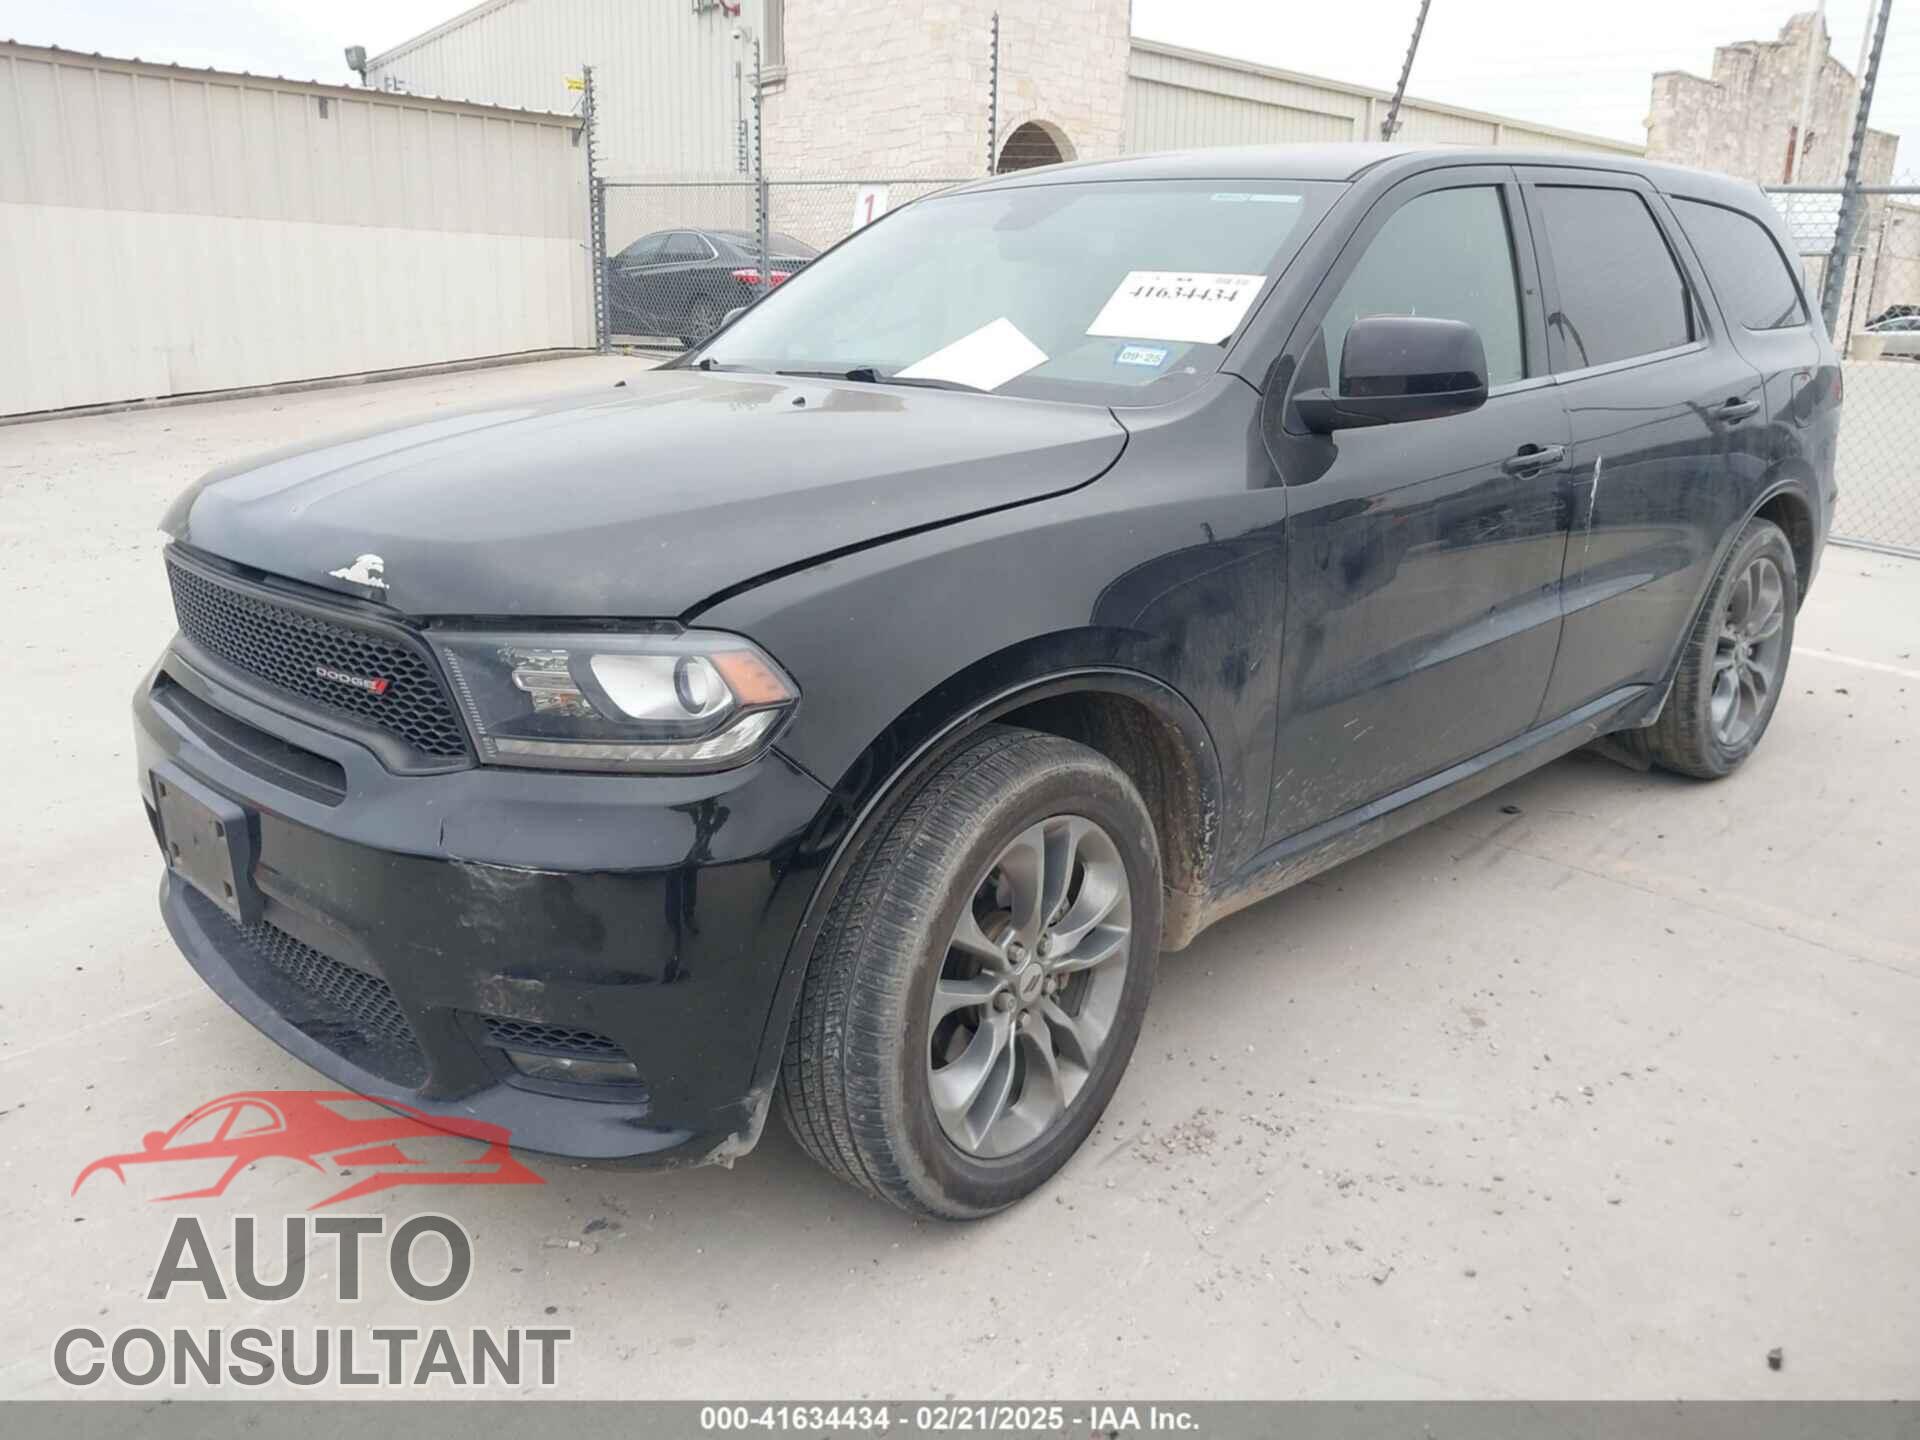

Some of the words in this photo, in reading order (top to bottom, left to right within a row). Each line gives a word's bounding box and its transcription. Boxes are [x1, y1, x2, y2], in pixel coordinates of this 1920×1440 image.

[864, 194, 875, 224] 1
[1129, 286, 1239, 301] 41634434
[316, 666, 371, 689] DODGE
